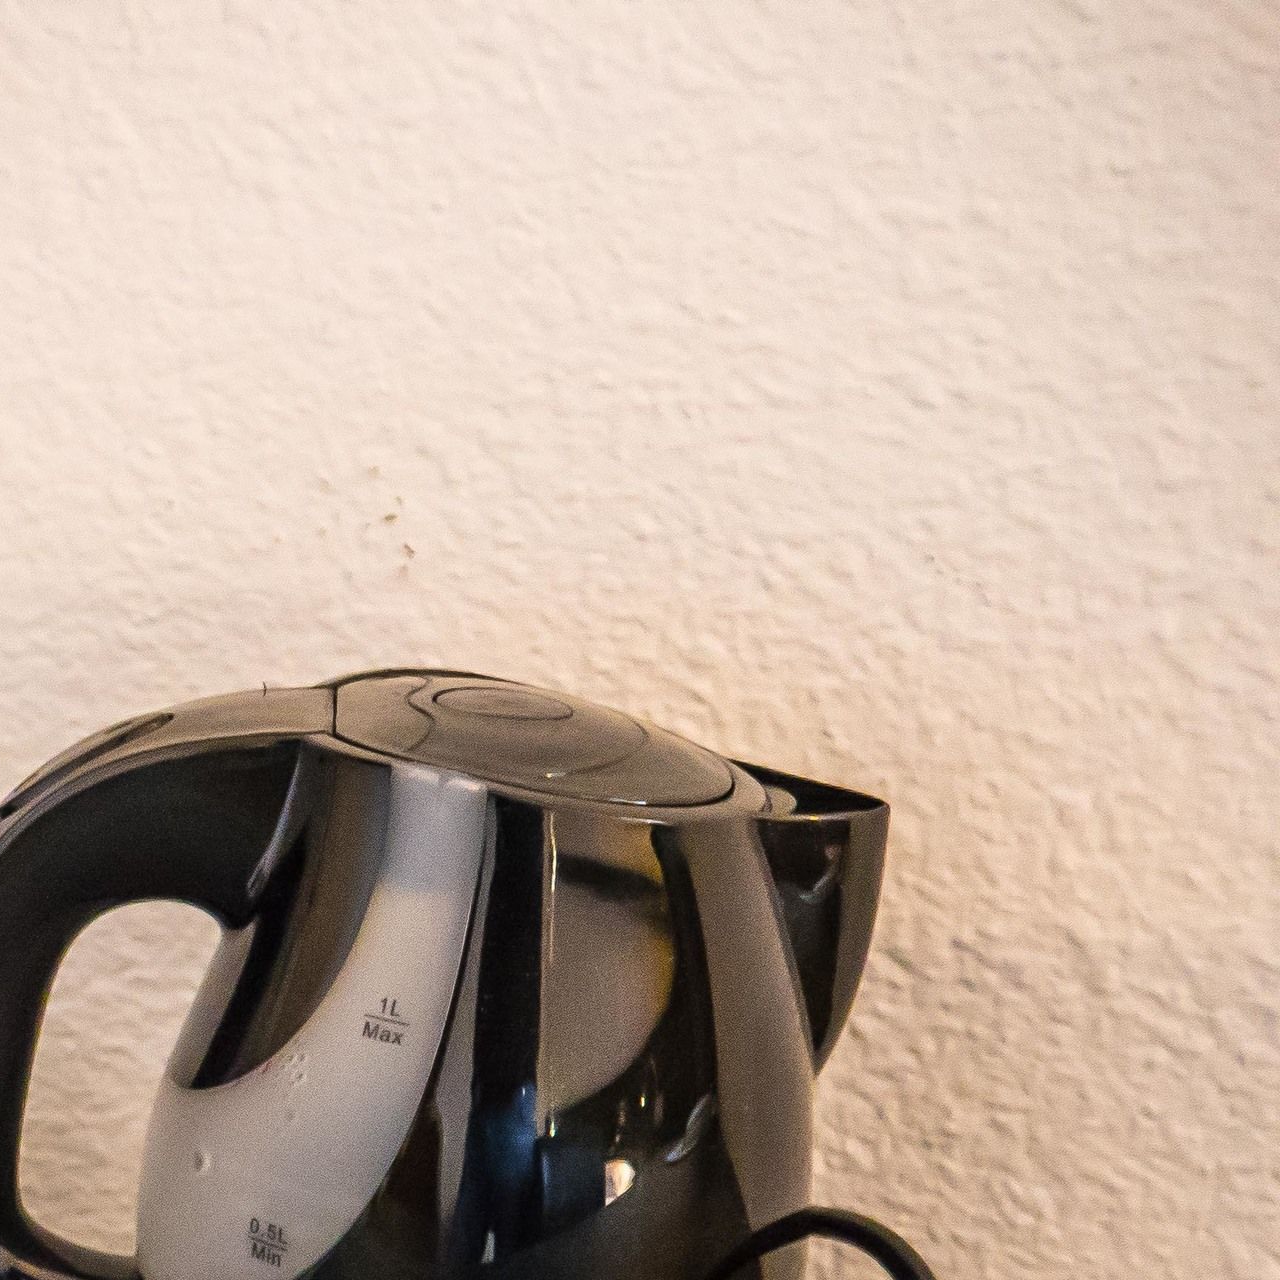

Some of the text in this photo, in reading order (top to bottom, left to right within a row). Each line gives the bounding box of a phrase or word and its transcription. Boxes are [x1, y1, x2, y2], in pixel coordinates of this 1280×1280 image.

[381, 997, 401, 1017] 1L
[362, 1021, 405, 1047] Max
[251, 1241, 282, 1268] Min
